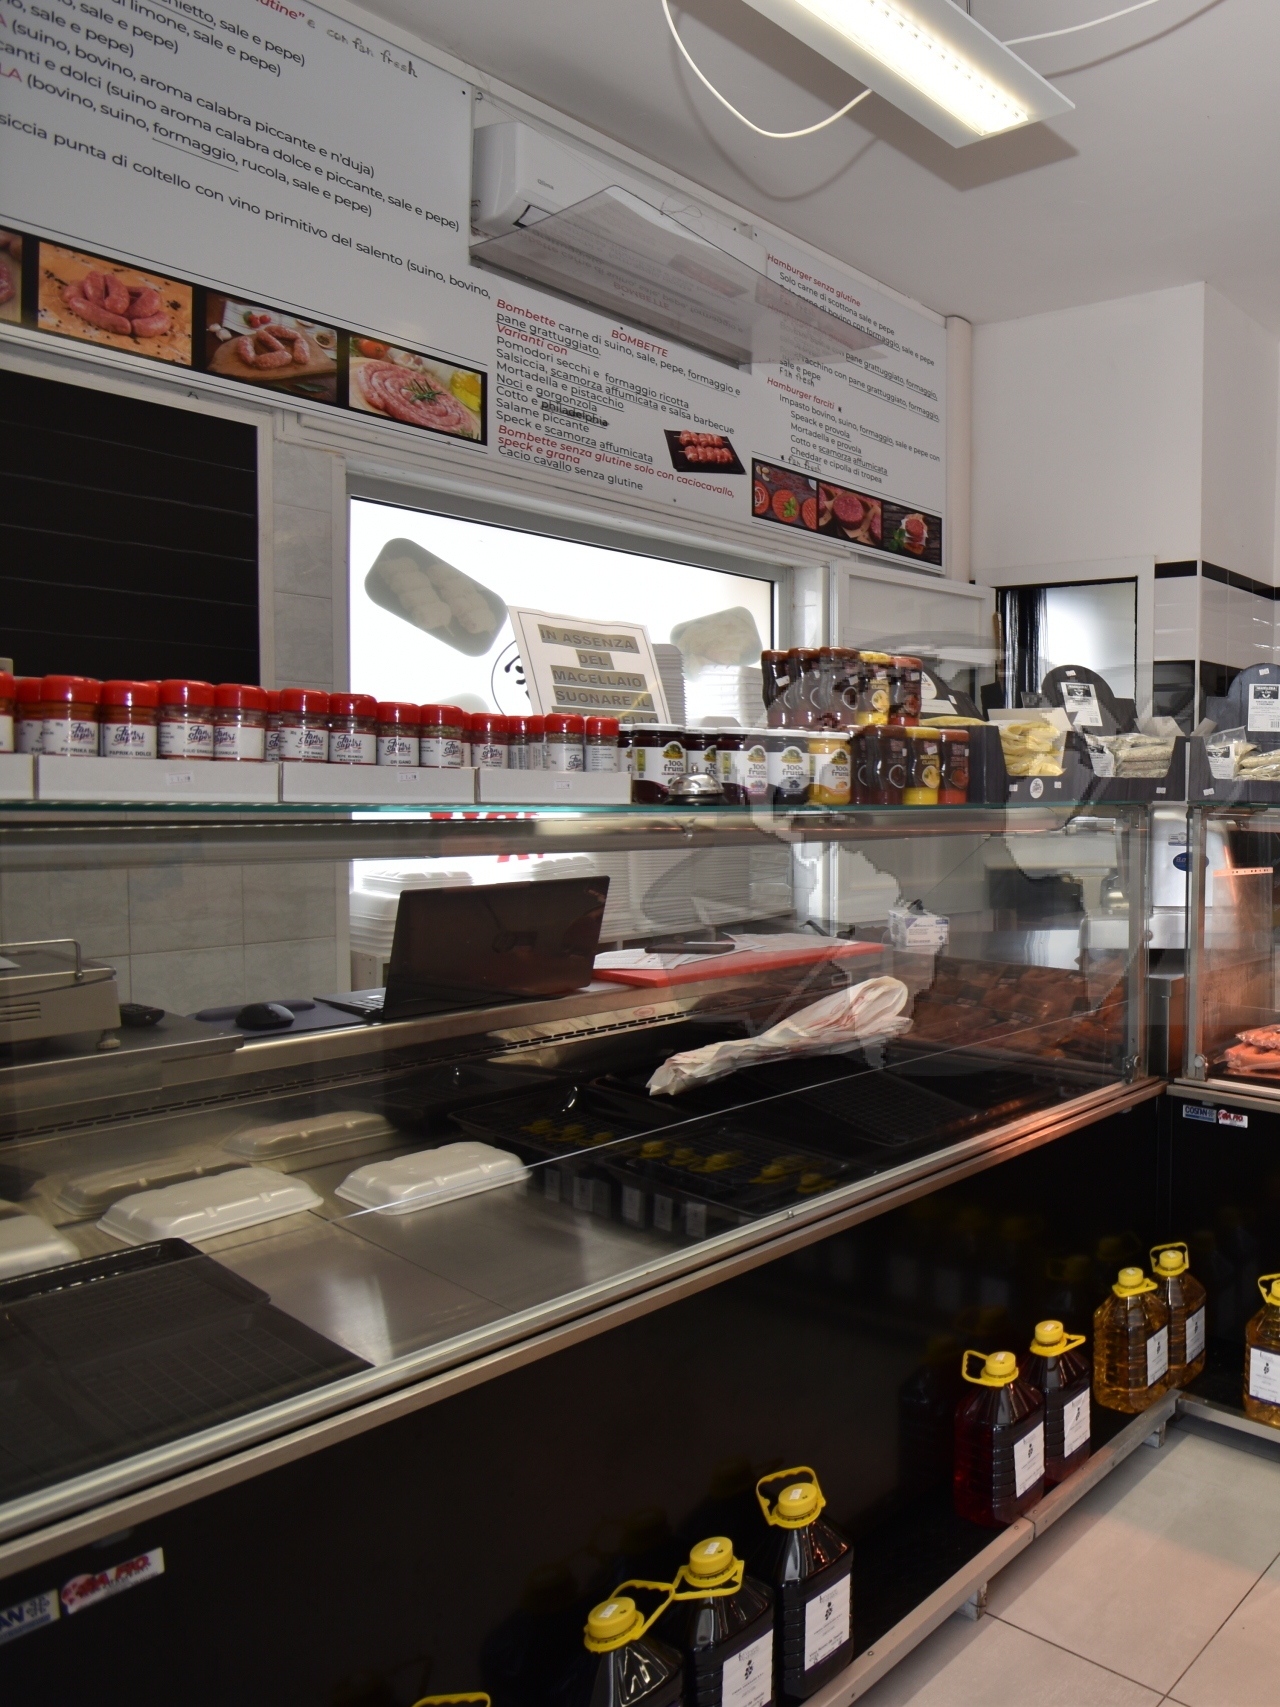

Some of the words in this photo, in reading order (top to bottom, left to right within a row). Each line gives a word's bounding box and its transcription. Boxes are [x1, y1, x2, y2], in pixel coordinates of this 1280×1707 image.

[31, 5, 66, 27] sale
[86, 28, 134, 58] pepe)
[80, 4, 114, 24] sale
[132, 25, 179, 54] pepe)
[220, 20, 249, 39] sale
[265, 40, 305, 67] pepe)
[193, 30, 224, 49] sale
[240, 50, 281, 77] pepe)
[12, 19, 70, 55] (suino,
[75, 45, 136, 81] bovino,
[140, 74, 193, 102] aroma
[196, 97, 251, 126] calabra
[255, 119, 316, 152] piccante
[331, 152, 375, 179] n'duja)
[27, 73, 97, 112] (bovino,
[100, 103, 150, 132] suino,
[153, 122, 239, 166] formaggio,
[242, 157, 290, 186] rucola,
[292, 177, 320, 195] sale
[335, 193, 372, 218] pepe)
[45, 58, 56, 70] e
[60, 63, 102, 89] dolci
[107, 81, 157, 110] (suino
[160, 103, 212, 132] aroma
[216, 125, 270, 155] calabra
[273, 149, 312, 172] dolce
[326, 169, 385, 202] piccante,
[388, 194, 413, 212] sale
[426, 209, 460, 232] pepe)
[54, 133, 106, 160] punta
[111, 154, 128, 168] di
[132, 162, 191, 190] coltello
[195, 185, 224, 202] con
[228, 195, 261, 214] vino
[265, 208, 328, 240] primitivo
[331, 233, 352, 248] del
[355, 241, 403, 266] salento
[406, 259, 446, 284] (suino,
[449, 275, 491, 299] bovino,
[767, 254, 812, 282] Hamburger
[813, 277, 835, 294] senza
[836, 289, 861, 307] glutine
[779, 272, 796, 286] Solo
[797, 282, 818, 298] carne
[828, 296, 858, 318] scottona
[878, 323, 895, 336] pepe
[496, 312, 526, 329] pane
[529, 324, 602, 356] grattuggiato.
[496, 324, 544, 348] Varianti
[496, 299, 556, 328] Bombette
[558, 323, 589, 340] carne
[604, 340, 634, 358] suino,
[688, 369, 733, 394] formaggio
[611, 329, 668, 358] BOMBETTE
[496, 336, 554, 363] Pomodori
[556, 356, 591, 376] secchi
[605, 372, 657, 398] formaggio
[659, 392, 689, 409] ricotta
[803, 369, 821, 381] pepe
[846, 352, 863, 365] pane
[496, 361, 558, 388] Mortadella
[571, 384, 624, 409] pistacchio
[496, 349, 548, 374] Salsiccia,
[551, 368, 602, 391] scamorza
[605, 386, 658, 410] affumicata
[694, 414, 735, 435] barbecue
[496, 373, 523, 389] Noci
[536, 386, 598, 412] gorgonzola
[496, 386, 528, 403] Cotto
[767, 377, 812, 400] Hamburger
[813, 395, 835, 409] farciti
[849, 376, 866, 388] pane
[496, 398, 539, 418] Salame
[542, 412, 590, 433] piccante
[780, 394, 810, 413] Impasto
[812, 404, 837, 423] bovino,
[838, 417, 859, 431] suino,
[790, 410, 817, 428] Speack
[825, 424, 850, 439] provola
[496, 410, 532, 429] Speck
[544, 426, 597, 447] scamorza
[599, 441, 653, 463] affumicata
[498, 425, 557, 448] Bombette
[560, 443, 592, 458] senza
[594, 452, 632, 469] glutine
[498, 436, 533, 452] speck
[546, 449, 580, 465] grana
[790, 423, 830, 443] Mortadella
[837, 439, 862, 454] provola
[790, 435, 811, 448] Cotto
[818, 445, 852, 462] scamorza
[852, 456, 888, 475] affumicata
[498, 446, 531, 461] Cacio
[533, 455, 572, 472] cavallo
[574, 466, 605, 481] senza
[607, 474, 644, 491] glutine
[790, 446, 822, 463] Cheddar
[829, 459, 852, 474] cipolla
[861, 470, 883, 484] tropea
[540, 628, 557, 641] IN
[563, 631, 634, 649] ASSENZA
[552, 669, 642, 688] MACELLAIO
[579, 653, 608, 666] DEL
[555, 690, 632, 706] SUONARE
